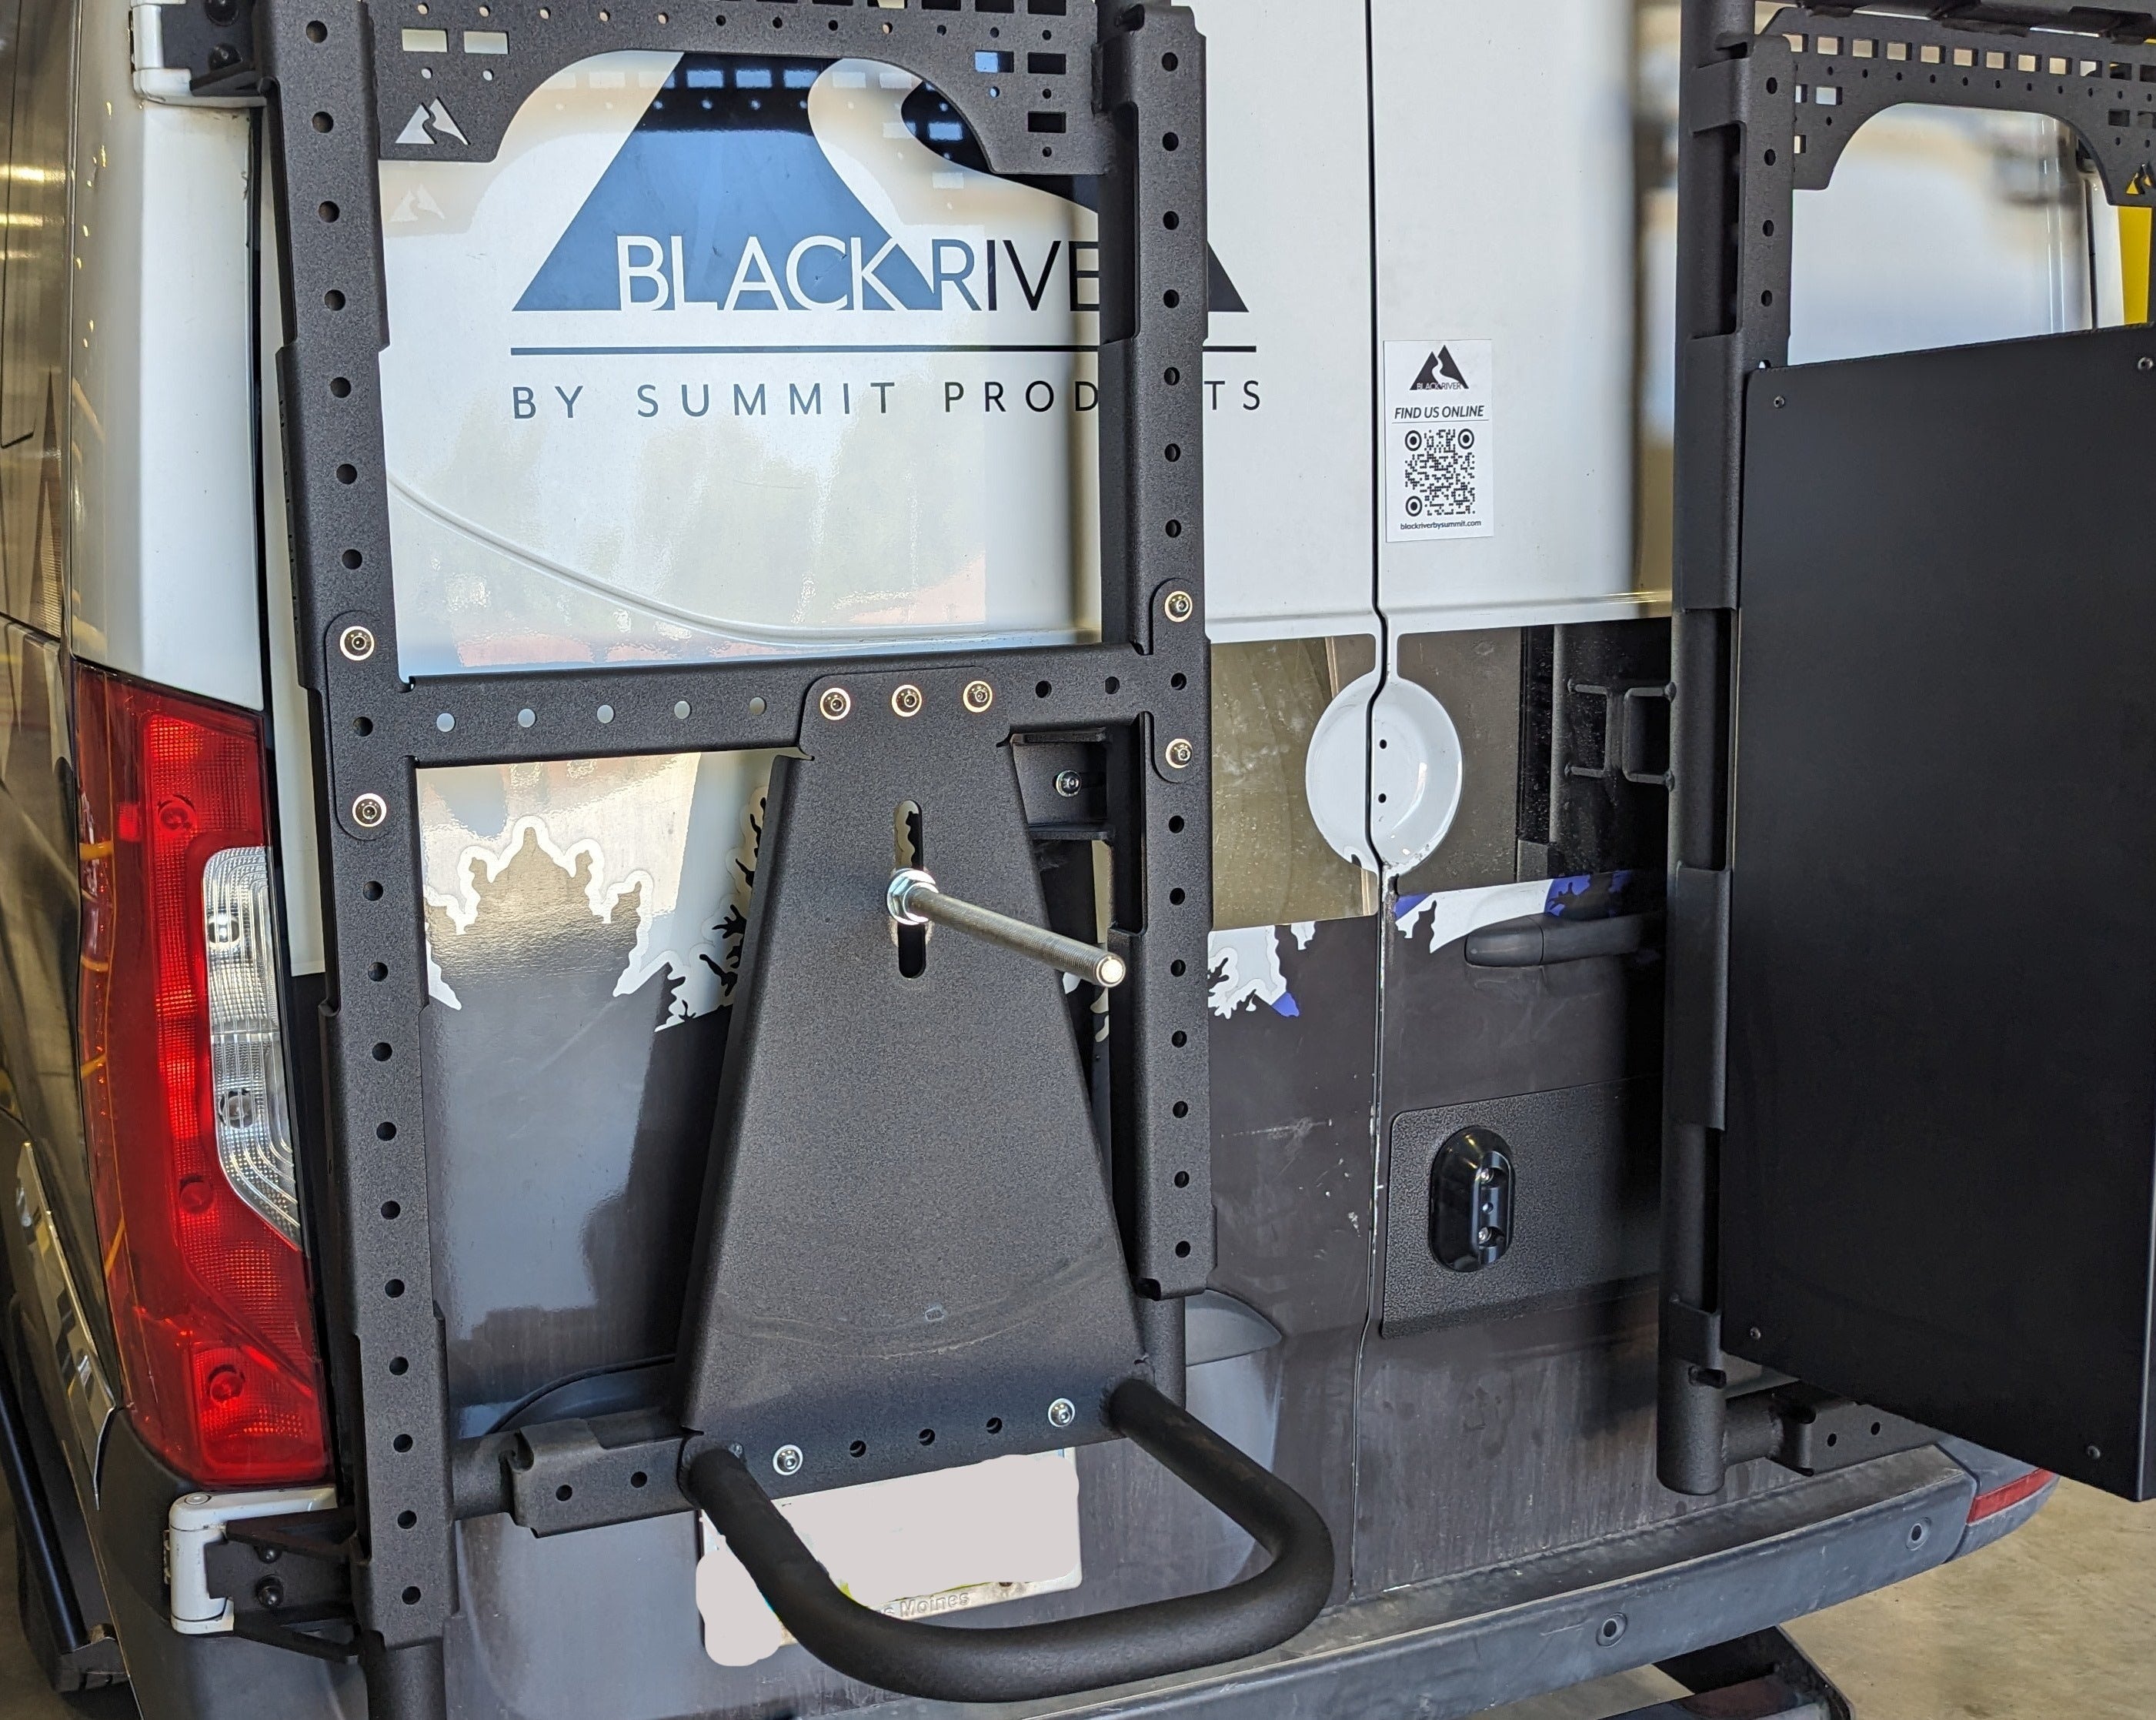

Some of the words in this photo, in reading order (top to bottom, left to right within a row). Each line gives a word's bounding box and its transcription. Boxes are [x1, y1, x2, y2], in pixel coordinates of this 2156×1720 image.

[932, 240, 1100, 312] RIVE
[512, 385, 583, 419] BY
[637, 382, 895, 417] SUMMIT
[944, 380, 1260, 412] PRODTS
[1394, 407, 1422, 419] FIND
[1424, 406, 1440, 419] US
[1442, 405, 1485, 418] ONLINE
[1400, 520, 1482, 530] blackriverbysummit.com
[899, 1592, 970, 1617] Moines
